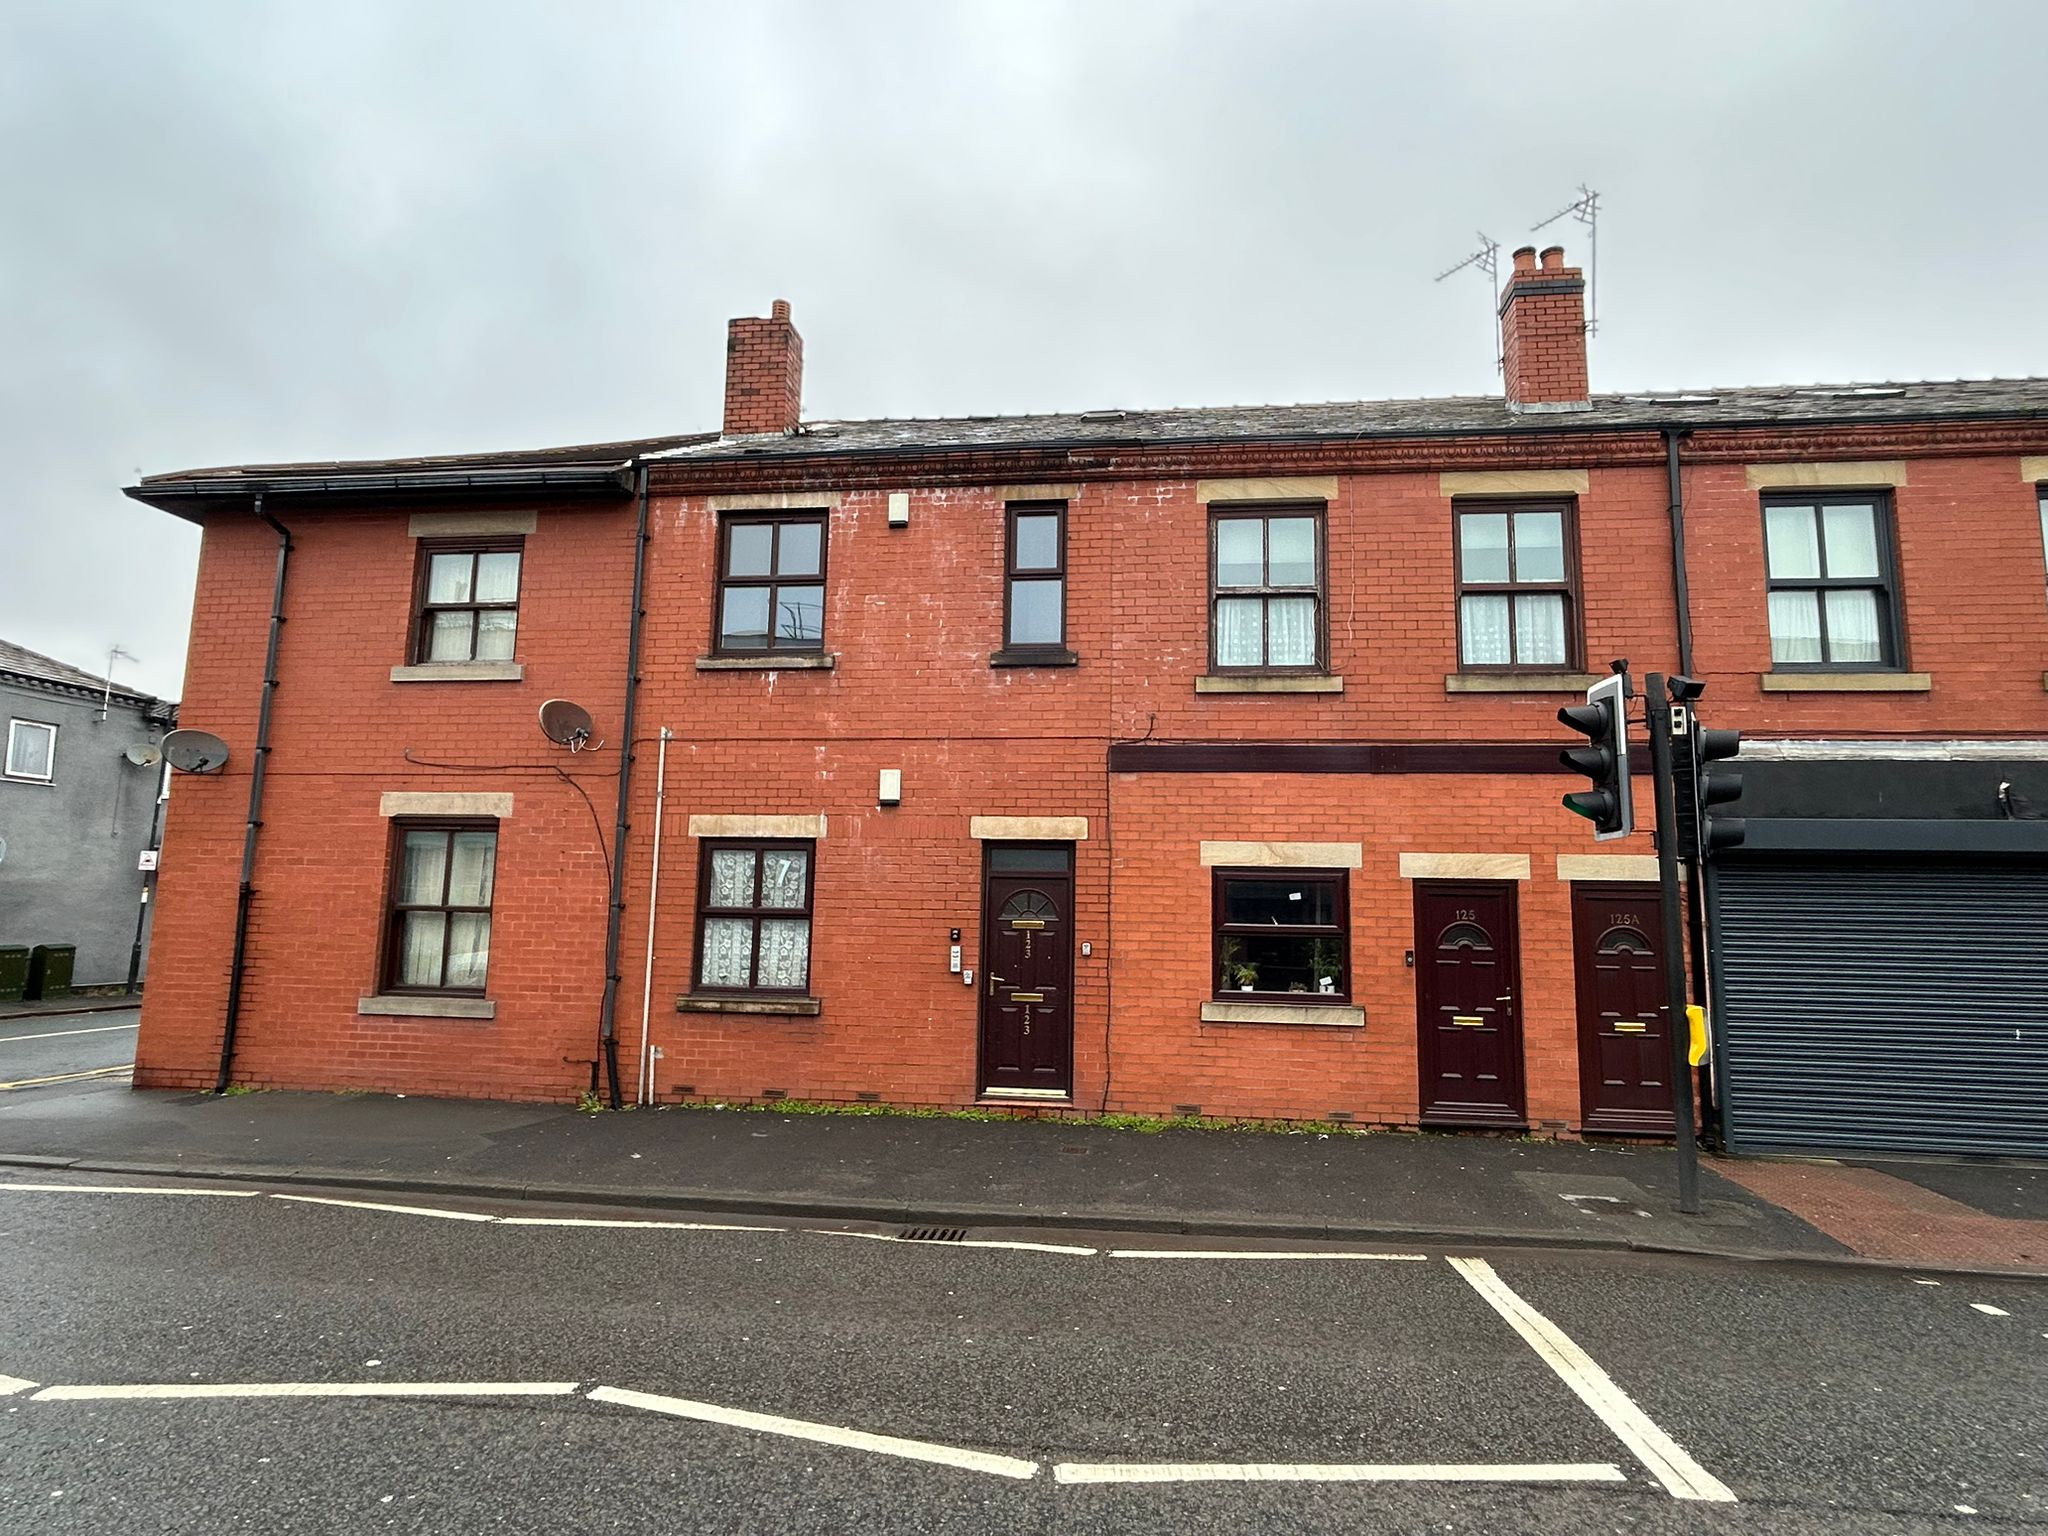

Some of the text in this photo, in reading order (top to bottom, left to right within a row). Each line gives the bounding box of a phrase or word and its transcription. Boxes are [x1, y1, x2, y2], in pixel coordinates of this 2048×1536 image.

[1456, 910, 1476, 920] 125
[1610, 914, 1640, 925] 125A
[1023, 1004, 1031, 1035] 123
